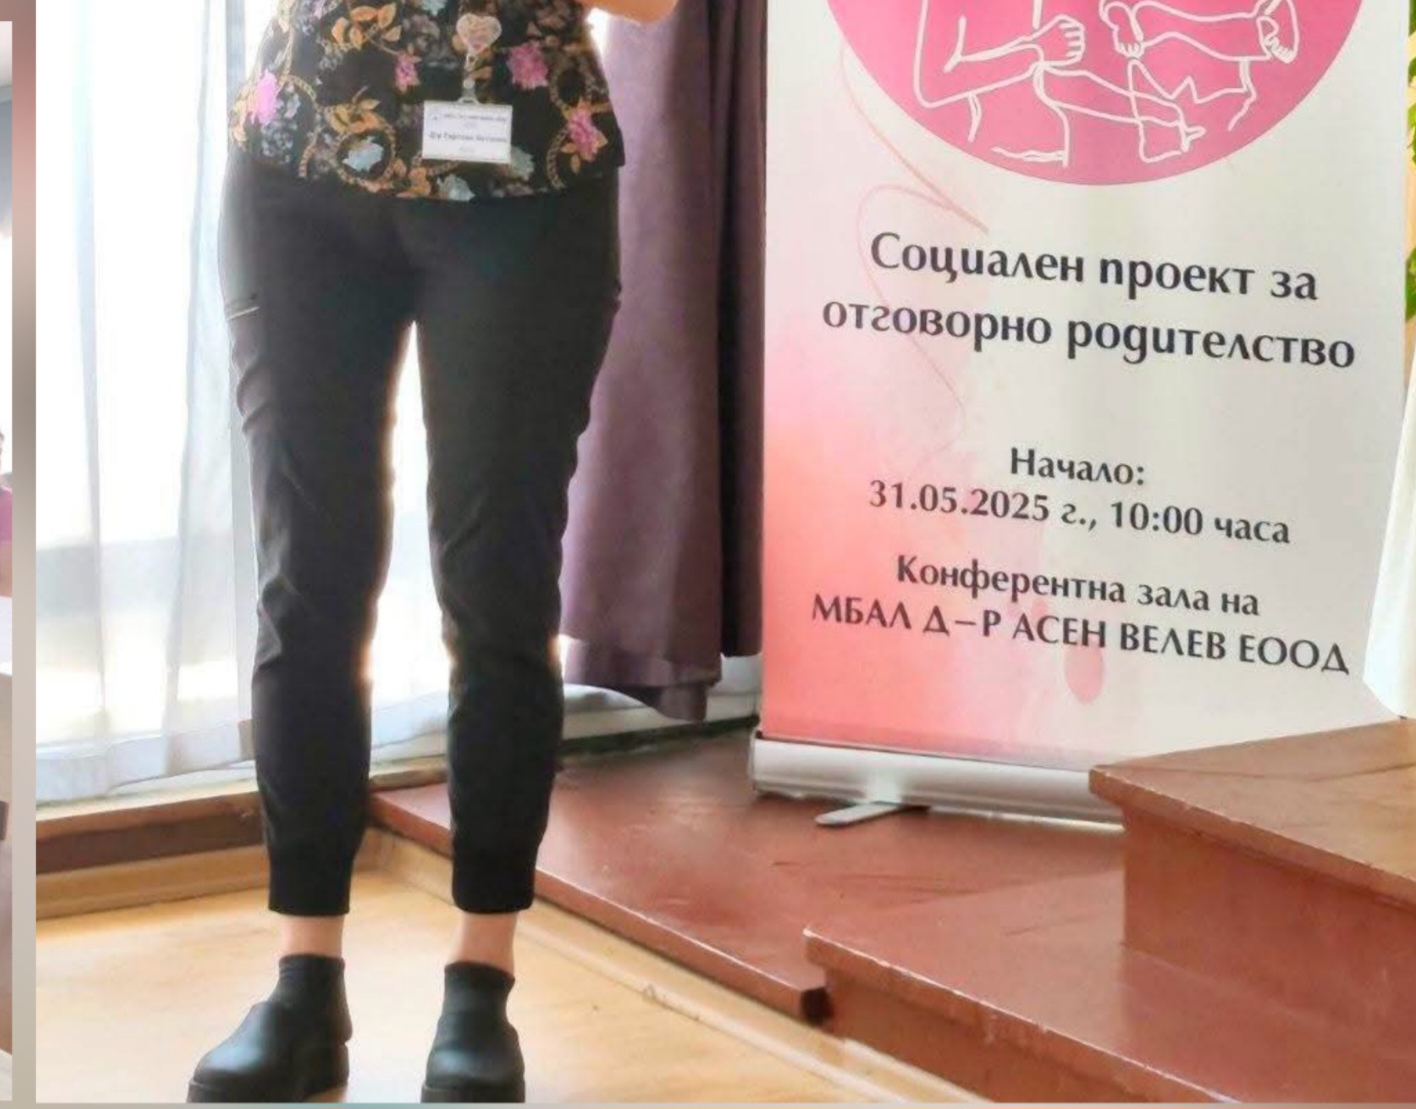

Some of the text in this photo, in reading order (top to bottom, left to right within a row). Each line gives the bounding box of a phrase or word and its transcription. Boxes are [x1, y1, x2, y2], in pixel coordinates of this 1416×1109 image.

[870, 231, 1319, 301] Социален проект за
[822, 301, 1355, 369] отговорно родителство
[1010, 446, 1145, 486] Начало:
[869, 479, 1291, 544] 31.05.2025 г., 10:00 часа
[896, 554, 1260, 616] Конферентна зала на
[812, 593, 912, 630] МБАЛ
[1011, 612, 1107, 649] АСЕН
[1119, 622, 1227, 660] ВЕЛЕВ
[1238, 634, 1350, 676] ЕООД
